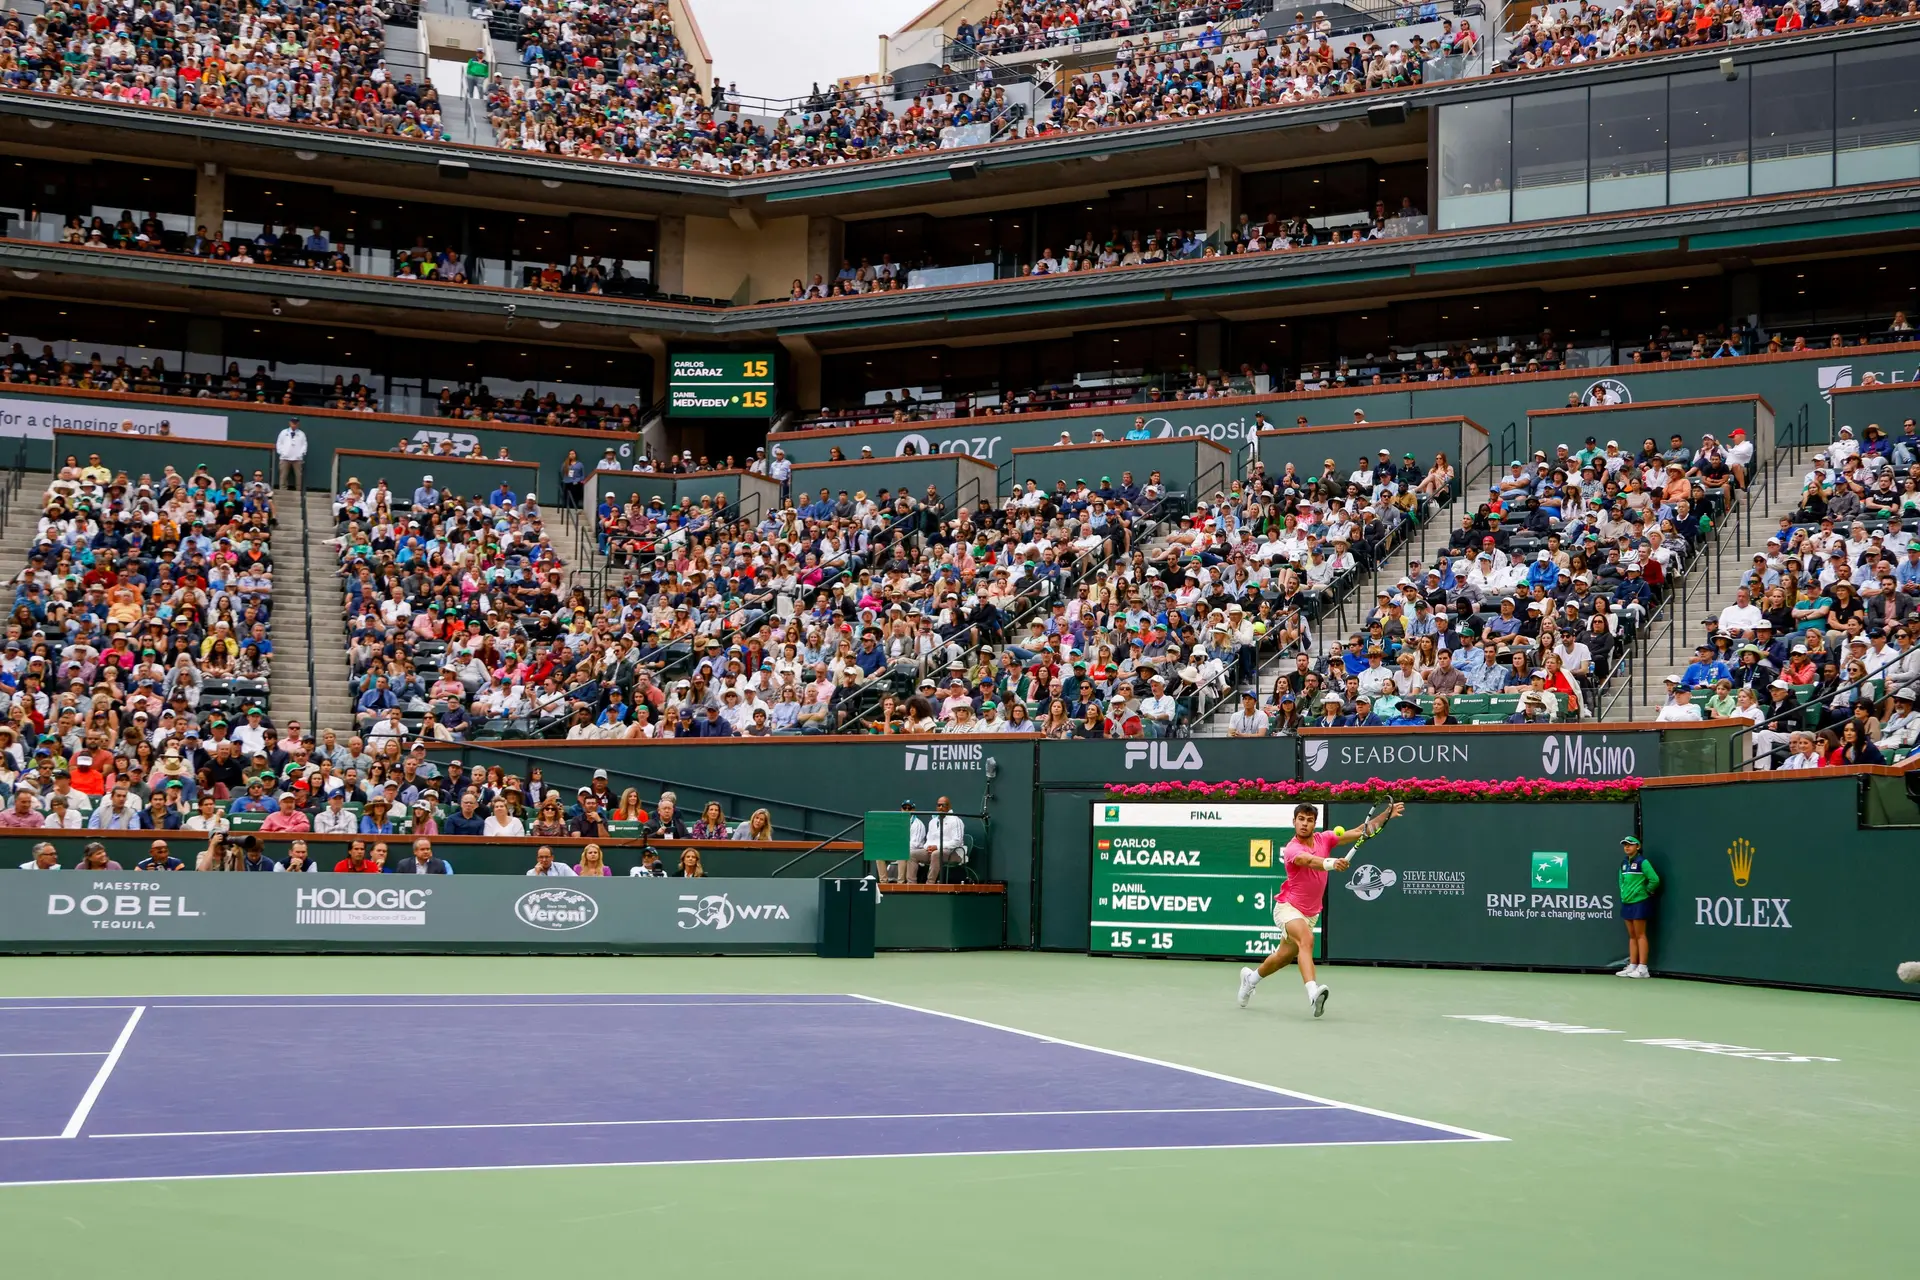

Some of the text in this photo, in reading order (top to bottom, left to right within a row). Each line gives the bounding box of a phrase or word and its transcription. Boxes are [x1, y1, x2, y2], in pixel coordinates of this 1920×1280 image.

[673, 360, 768, 377] ALCARAZ 15
[672, 391, 768, 408] MEDVEDEV 15
[27, 415, 37, 427] a
[43, 415, 118, 433] changing
[619, 443, 632, 458] 6
[931, 744, 983, 760] TENNIS
[1125, 741, 1203, 770] FILA
[1341, 744, 1469, 765] SEABOURN
[931, 761, 982, 770] CHANNEL
[1190, 811, 1222, 820] FINAL
[1113, 838, 1156, 848] CARLOS
[1113, 850, 1200, 866] ALCARAZ
[1255, 847, 1266, 863] 6
[1402, 870, 1465, 882] STEVE FURGAL'S
[93, 882, 160, 891] MAESTRO
[834, 879, 842, 892] 1
[859, 879, 869, 892] 2
[1112, 883, 1146, 893] DANIIL
[1112, 895, 1212, 912] MEDVEDEV
[1254, 892, 1266, 910] 3
[1487, 893, 1614, 909] BNP PARIBAS
[522, 903, 587, 922] Veroni
[736, 904, 790, 920] WTA
[1487, 908, 1502, 917] The
[1504, 909, 1525, 918] bank
[1525, 909, 1539, 919] for
[1547, 910, 1586, 920] changing
[1587, 910, 1613, 919] world
[1695, 896, 1792, 928] ROLEX
[92, 920, 156, 929] TEQUILA
[1111, 931, 1132, 948] 15
[1151, 932, 1173, 949] 15
